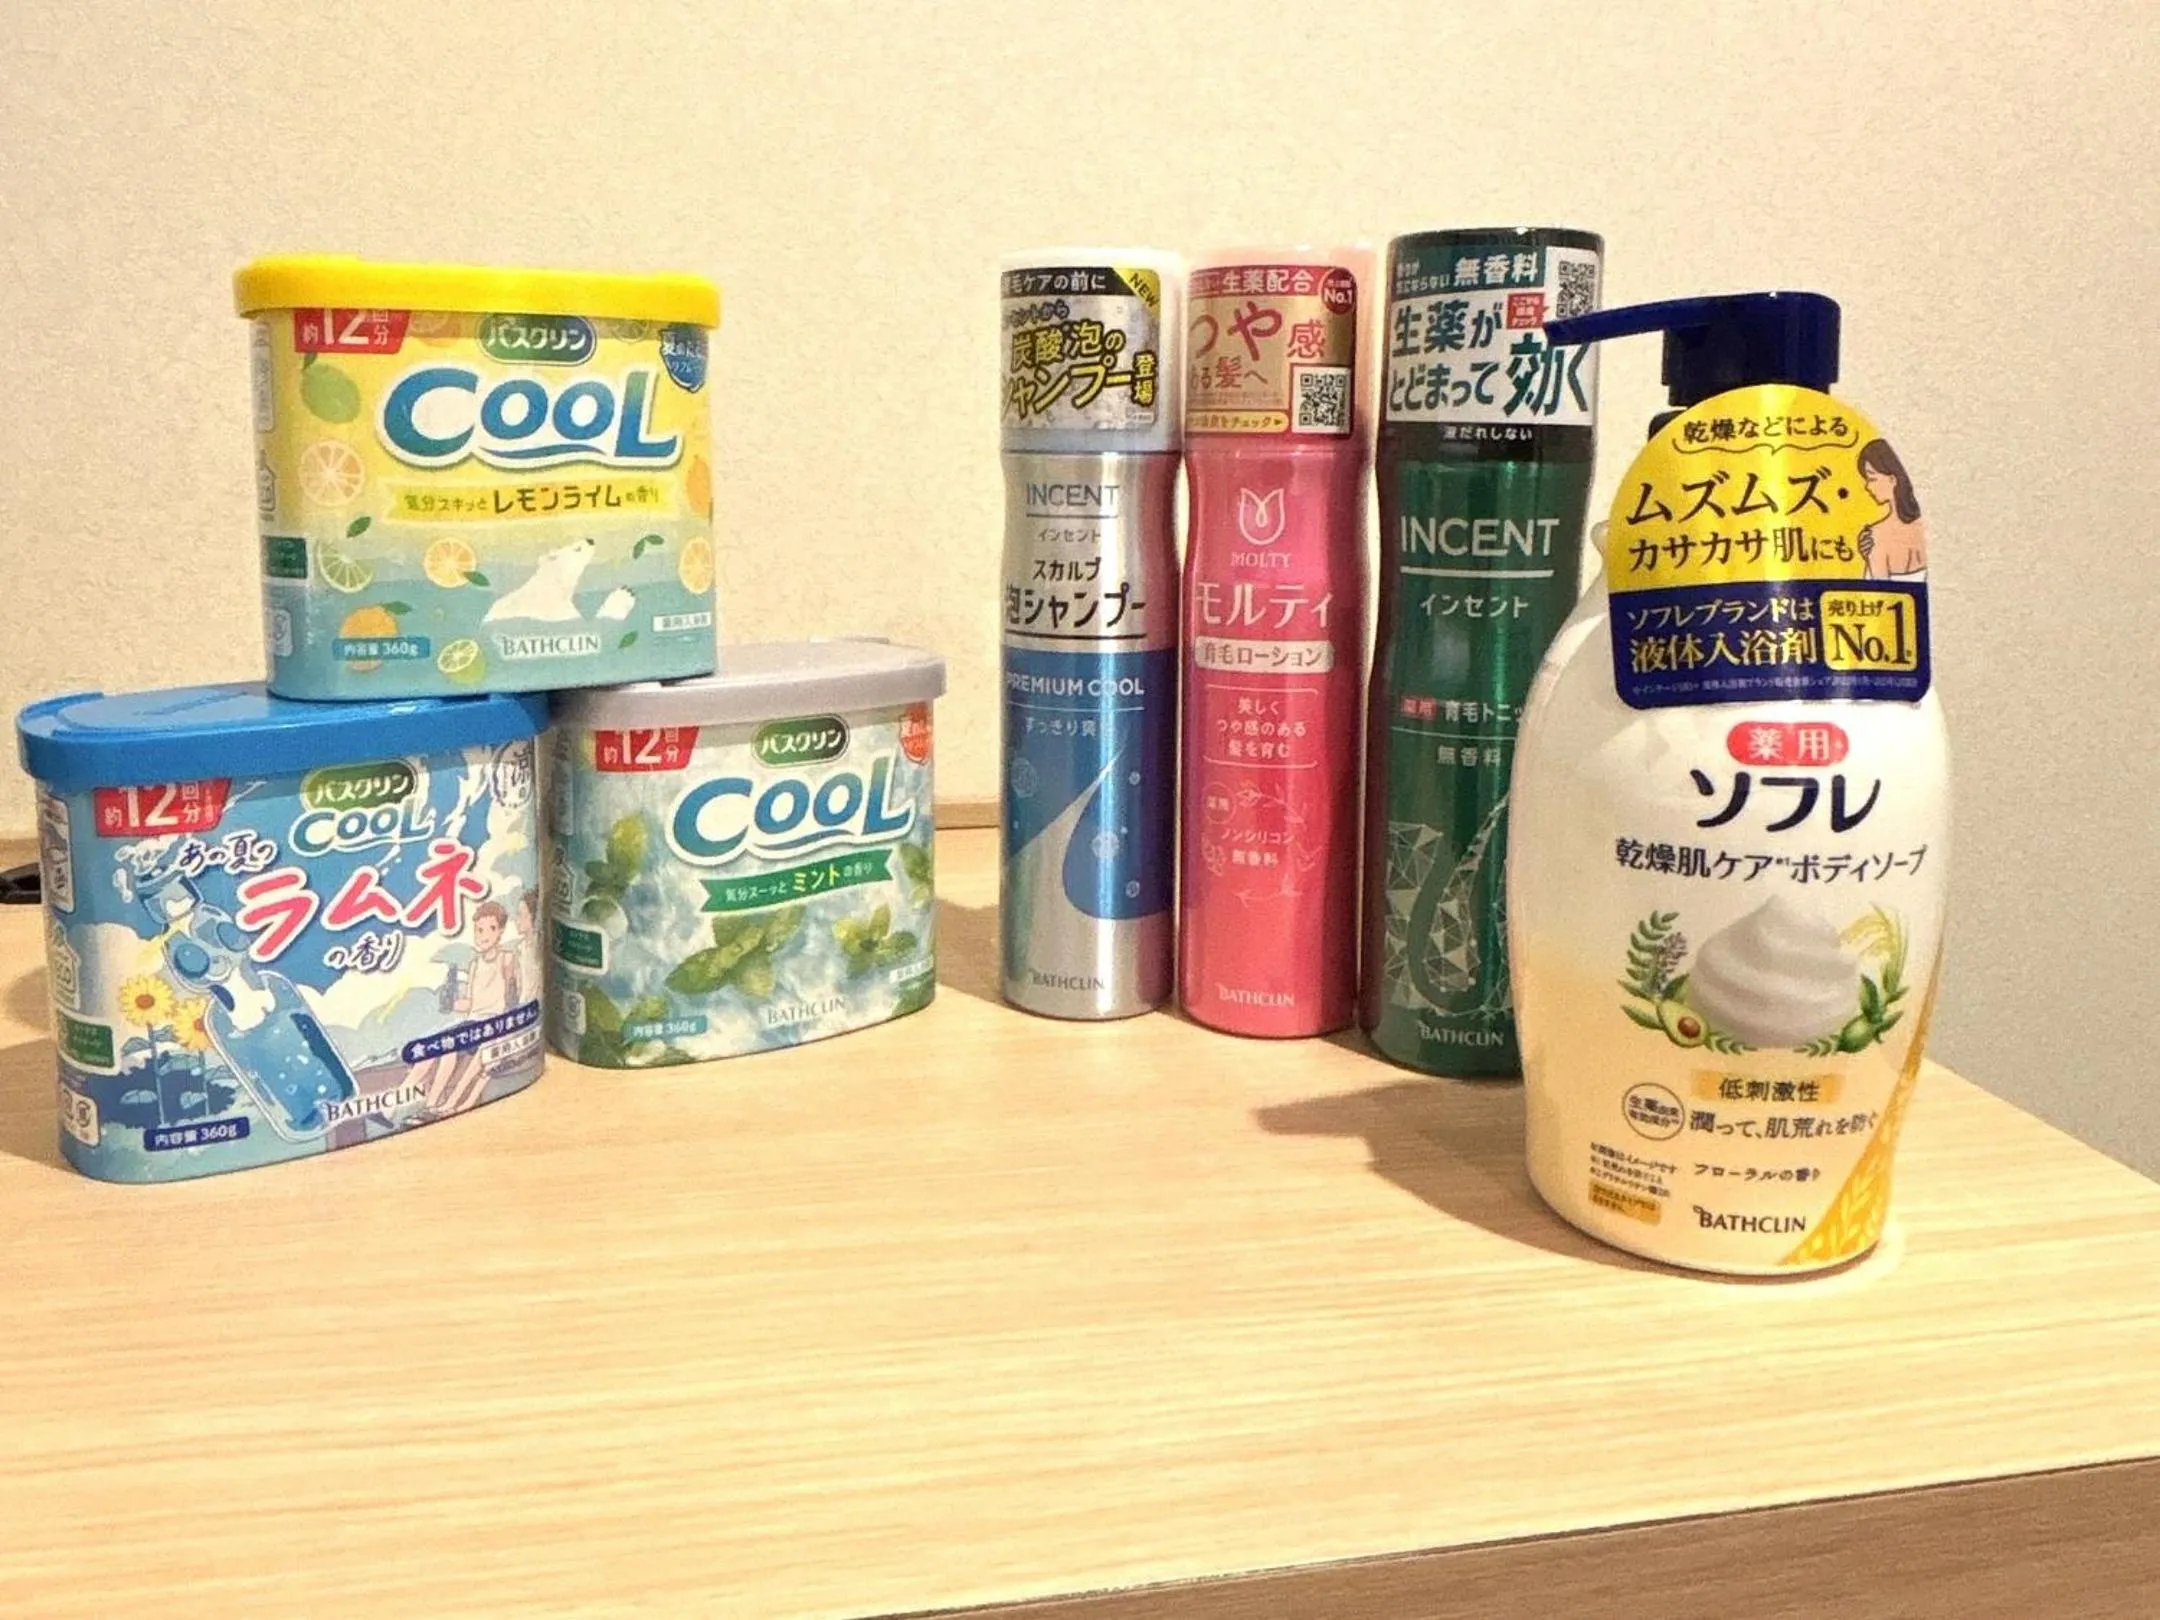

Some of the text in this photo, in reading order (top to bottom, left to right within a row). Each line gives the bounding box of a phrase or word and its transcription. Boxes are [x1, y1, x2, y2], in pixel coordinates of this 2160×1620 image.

[1002, 271, 1106, 294] 毛ケアの前に
[1221, 269, 1315, 293] 生薬配合
[1453, 252, 1538, 286] 無香料
[1128, 273, 1159, 308] NEW
[486, 314, 588, 352] バスクリン
[1392, 299, 1504, 357] 生薬が
[1133, 352, 1157, 407] 登場
[384, 367, 678, 460] COOL
[1684, 415, 1849, 444] 乾燥などによる
[1026, 483, 1121, 507] INCENT
[1039, 527, 1101, 543] インセント
[1400, 515, 1560, 556] INCENT
[1628, 526, 1854, 573] カサカサ肌にも
[1231, 551, 1293, 568] MOLTY
[1196, 582, 1334, 629] モルティ
[1420, 593, 1529, 620] インセント
[1627, 598, 1815, 630] ソフレブランドは
[500, 633, 600, 656] BATHCLIN
[1829, 601, 1912, 664] No.1
[1630, 627, 1817, 674] 液体入浴剤
[1006, 671, 1145, 696] PREMIUM COOL
[1237, 697, 1280, 716] 美しく
[761, 727, 843, 756] バスクリン
[1749, 727, 1830, 760] 薬用
[312, 774, 411, 803] バスクリン
[1689, 768, 1881, 834] ソフレ
[673, 756, 911, 857] COOL
[296, 805, 433, 853] COOL
[181, 834, 274, 871] あの夏の
[242, 844, 484, 959] ラムネ
[327, 932, 402, 969] の香り
[1030, 968, 1104, 991] BATHCLIN
[1219, 984, 1295, 1007] BATHCLIN
[766, 998, 845, 1025] BATHCLIN
[1416, 1020, 1504, 1046] BATHCLIN
[326, 1084, 427, 1122] BATHCLIN
[1718, 1078, 1820, 1103] 低刺激性
[1689, 1109, 1879, 1140] 潤って、肌荒れを防ぐ
[1693, 1163, 1821, 1183] フローラルの香り
[1693, 1204, 1807, 1232] BATHCLIN
